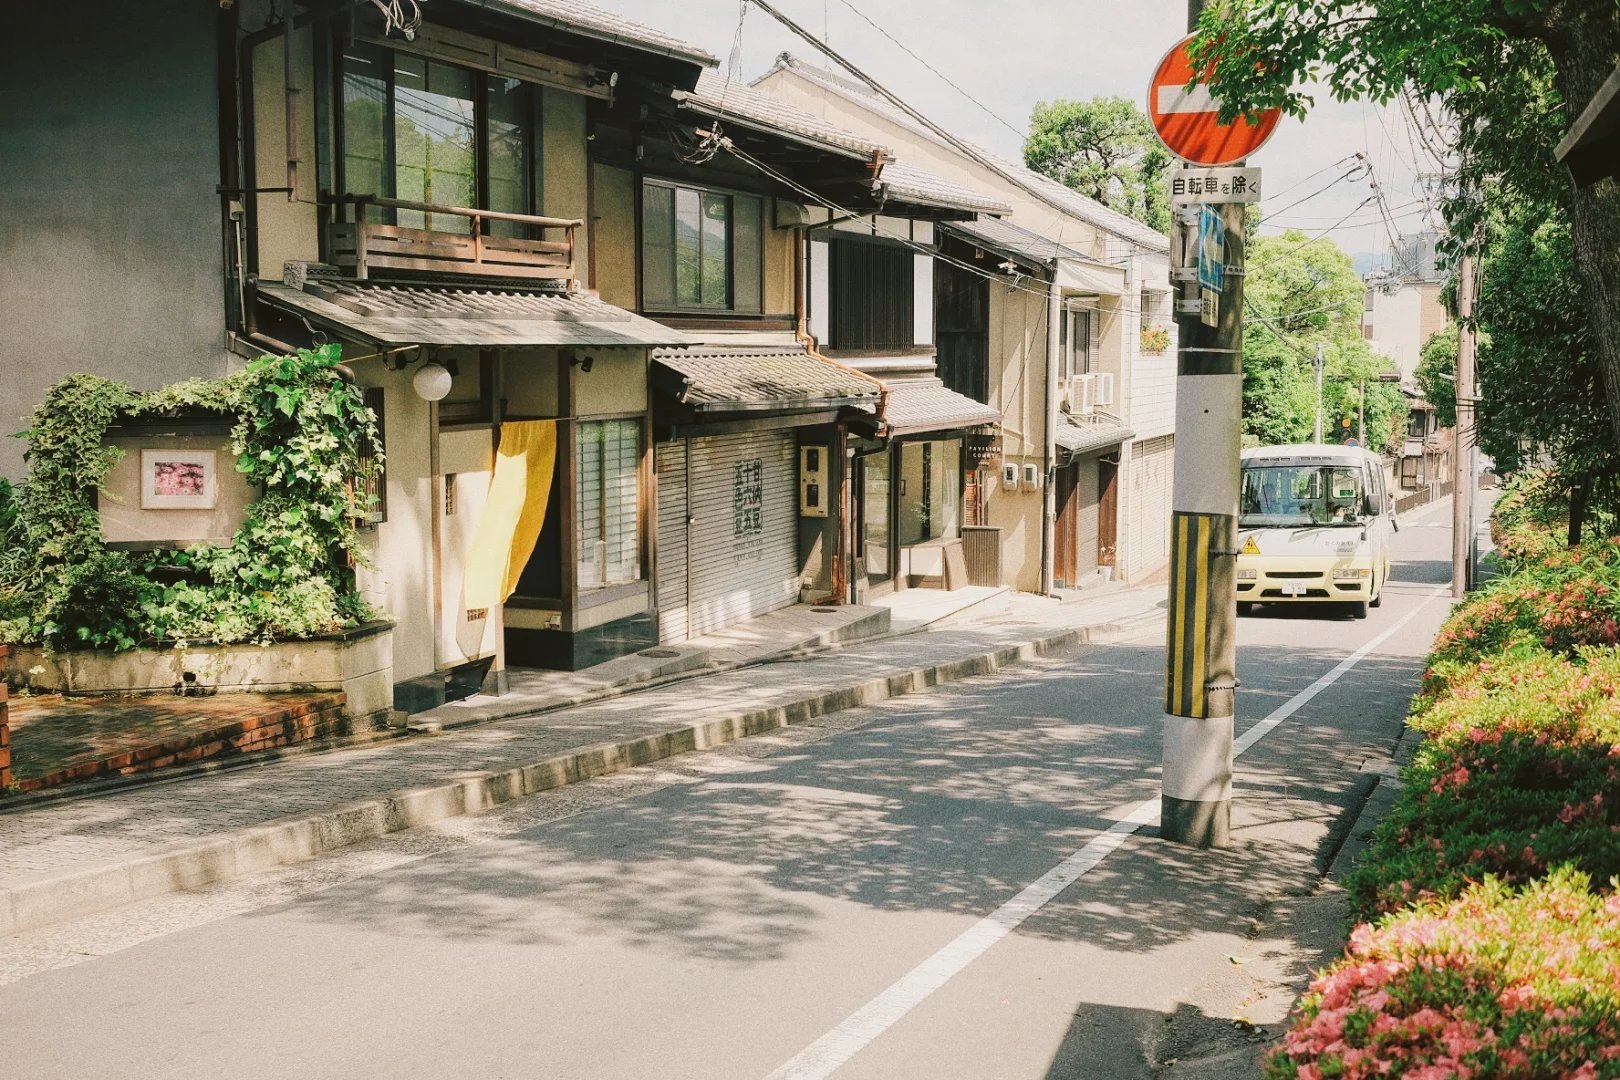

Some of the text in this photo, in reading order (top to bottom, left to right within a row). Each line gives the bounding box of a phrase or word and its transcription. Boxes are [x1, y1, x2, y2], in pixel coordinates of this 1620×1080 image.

[1172, 175, 1257, 195] 自転車を除く
[743, 462, 753, 530] 十六五
